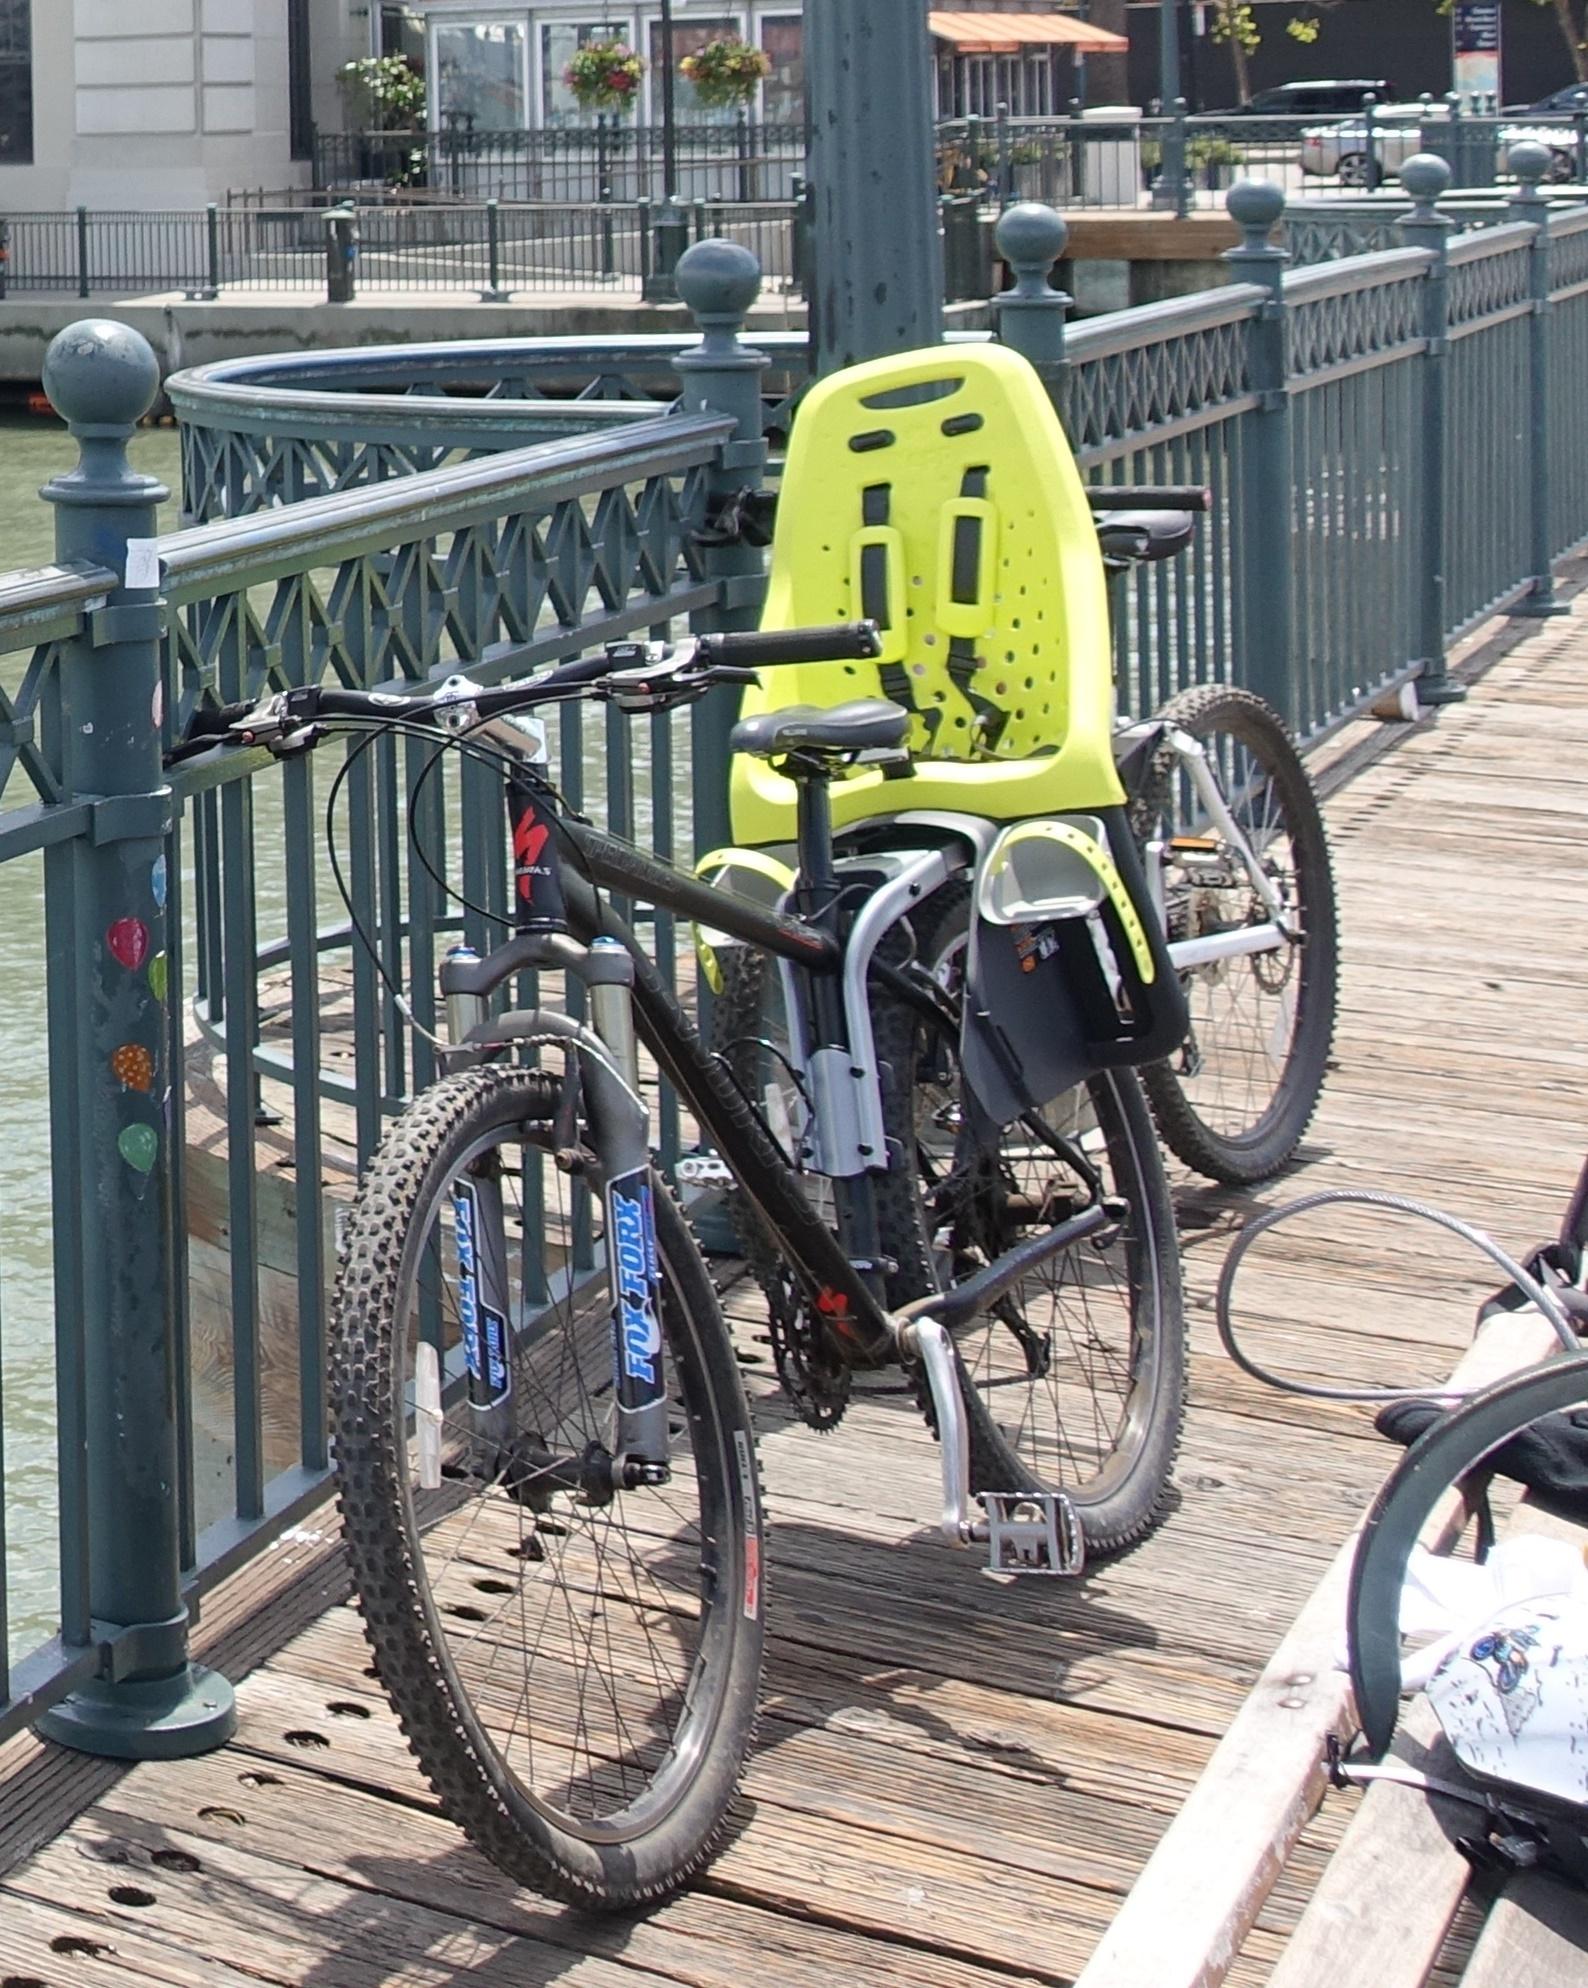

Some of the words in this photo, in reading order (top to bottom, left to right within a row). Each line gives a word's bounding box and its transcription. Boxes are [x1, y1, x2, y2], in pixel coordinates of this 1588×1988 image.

[453, 1197, 475, 1274] FOX
[611, 1190, 650, 1300] FORX
[621, 1299, 655, 1384] FOX
